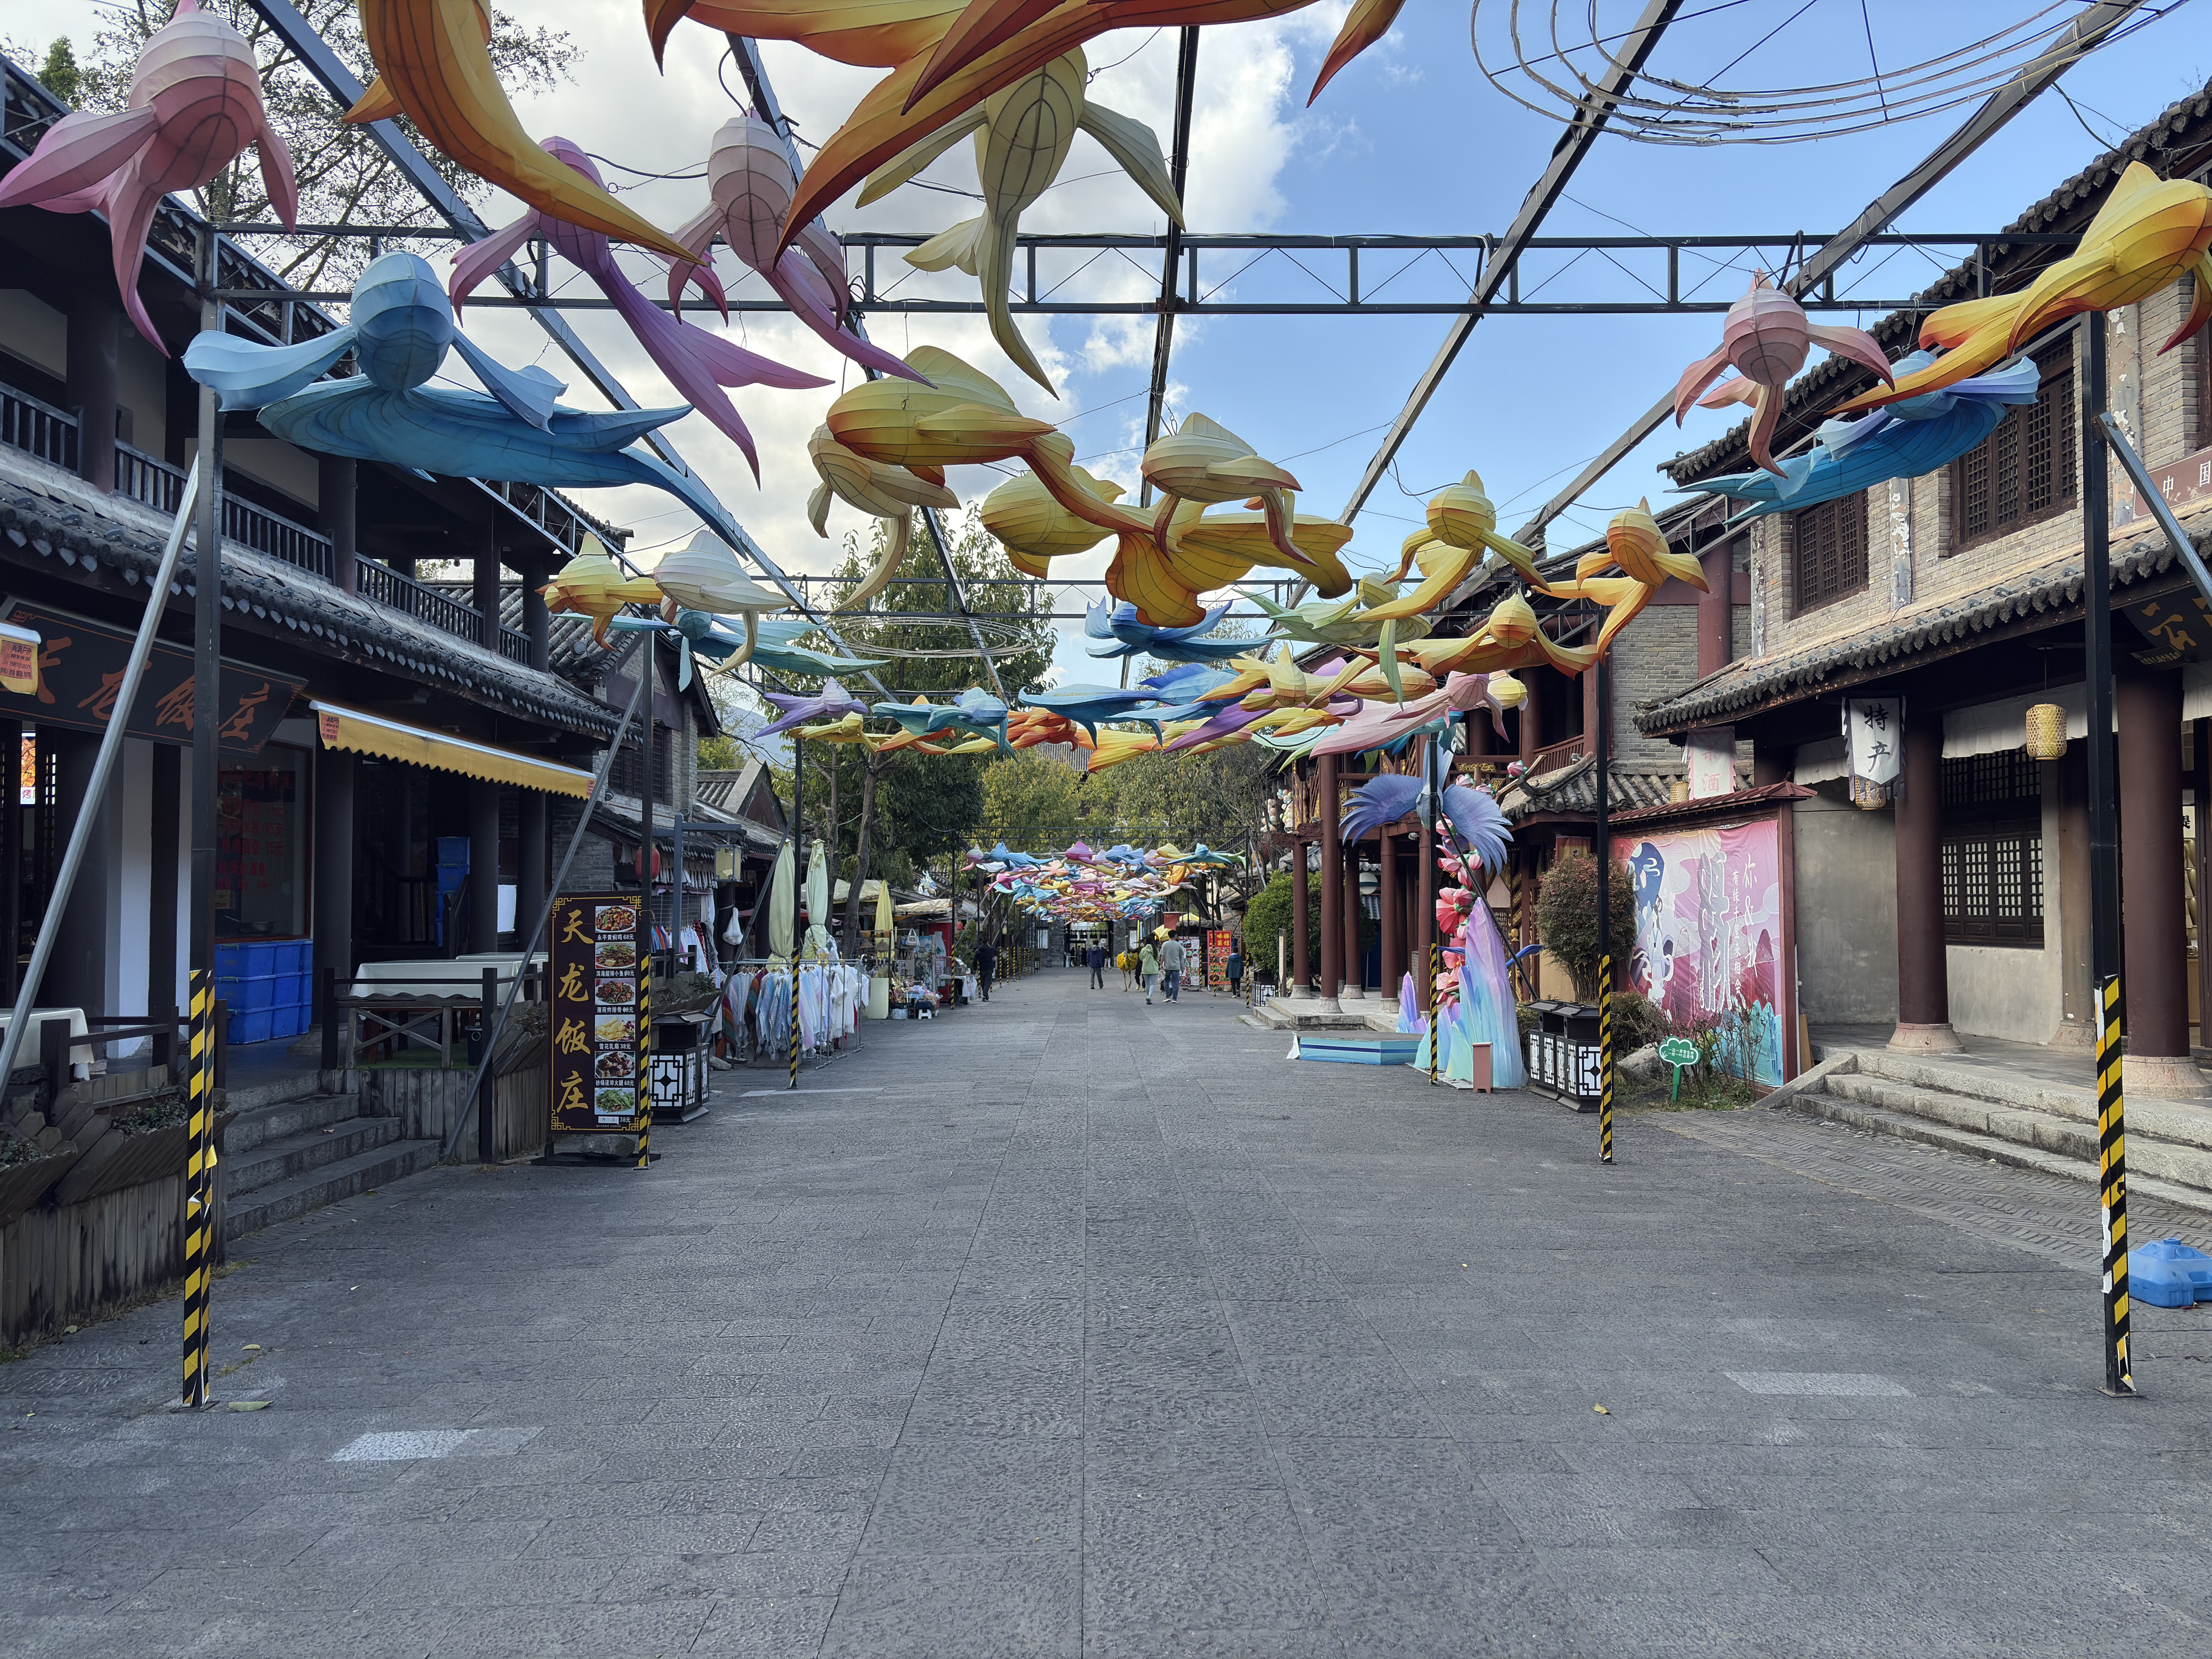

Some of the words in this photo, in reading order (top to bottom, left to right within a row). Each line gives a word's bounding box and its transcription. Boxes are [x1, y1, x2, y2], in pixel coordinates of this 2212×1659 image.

[2163, 460, 2211, 499] 中国
[1864, 703, 1890, 773] 特产
[22, 789, 35, 799] 烤
[1733, 870, 1742, 994] 有缘千里来相会
[1742, 853, 1758, 978] 你&我
[555, 909, 594, 1114] 天龙饭庄
